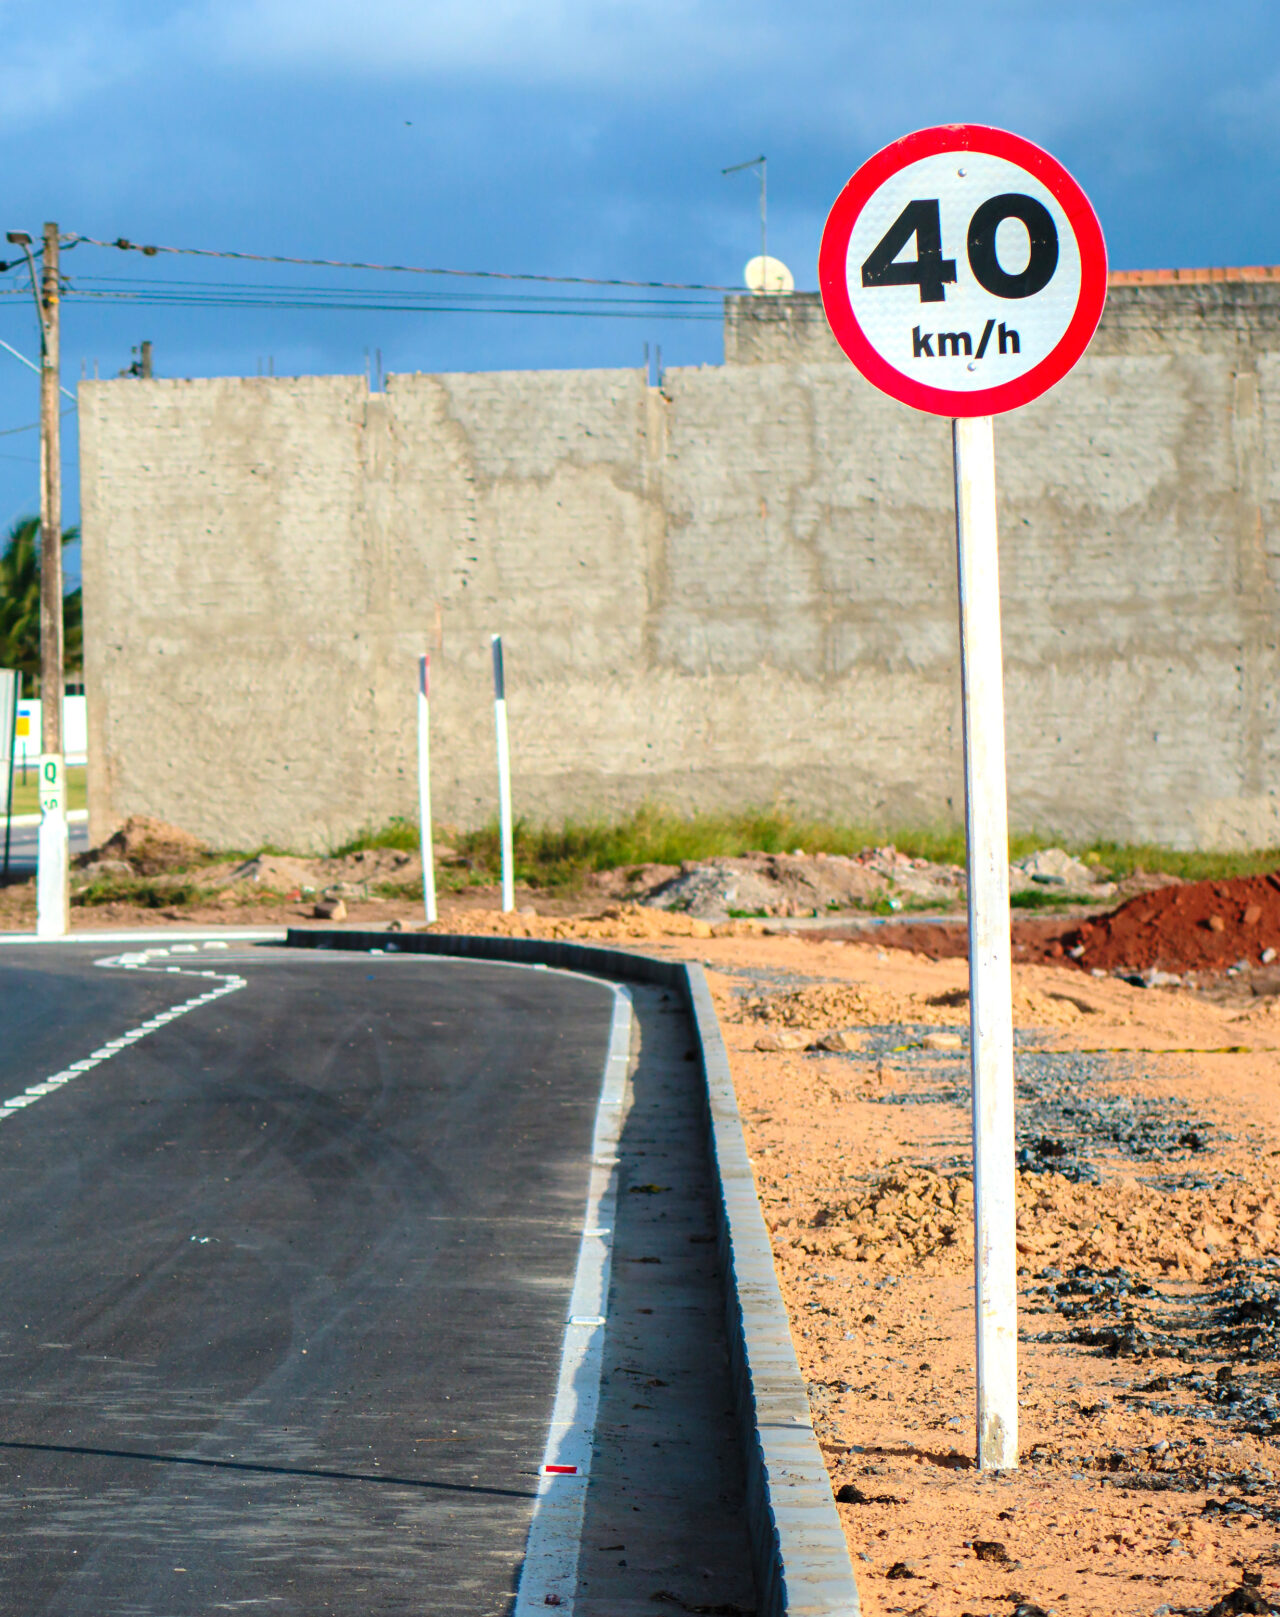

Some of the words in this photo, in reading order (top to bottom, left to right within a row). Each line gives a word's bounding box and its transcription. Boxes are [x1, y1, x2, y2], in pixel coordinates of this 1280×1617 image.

[861, 193, 1059, 303] 40
[911, 319, 1021, 359] km/h
[44, 762, 56, 784] Q
